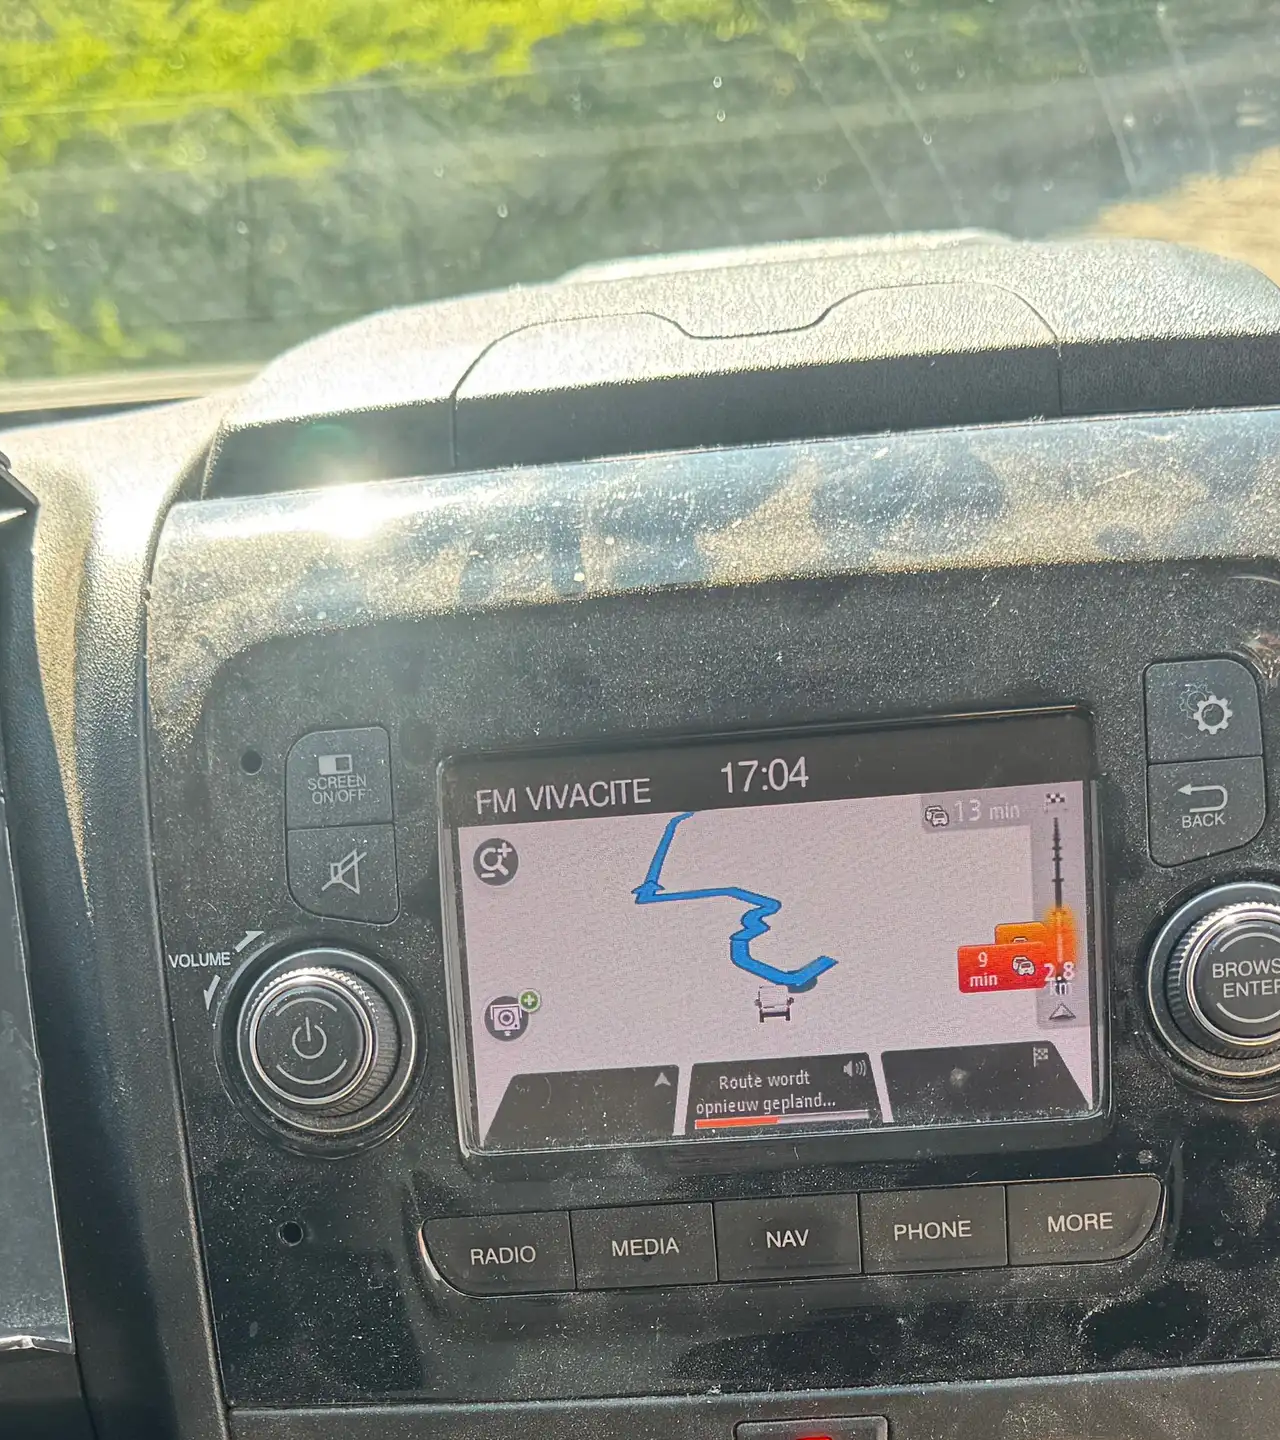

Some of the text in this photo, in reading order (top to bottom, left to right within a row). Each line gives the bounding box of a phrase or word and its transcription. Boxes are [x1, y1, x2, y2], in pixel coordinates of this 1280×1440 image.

[308, 776, 367, 790] SCREEN
[720, 756, 809, 793] 17:04
[312, 789, 366, 804] ON/OFF
[476, 778, 651, 814] FM VIVACITE
[954, 800, 1020, 821] 13 min
[1182, 813, 1225, 829] BACK
[169, 952, 231, 968] VOLUME
[978, 952, 988, 967] 9
[970, 974, 998, 987] min
[1043, 962, 1075, 982] 2.8
[719, 1070, 810, 1090] Route wordt
[696, 1092, 836, 1117] opnieuw gepland...
[894, 1220, 972, 1241] PHONE
[1047, 1212, 1113, 1232] MORE
[611, 1237, 680, 1257] MEDIA
[766, 1229, 809, 1248] NAV
[470, 1246, 537, 1265] RADIO
